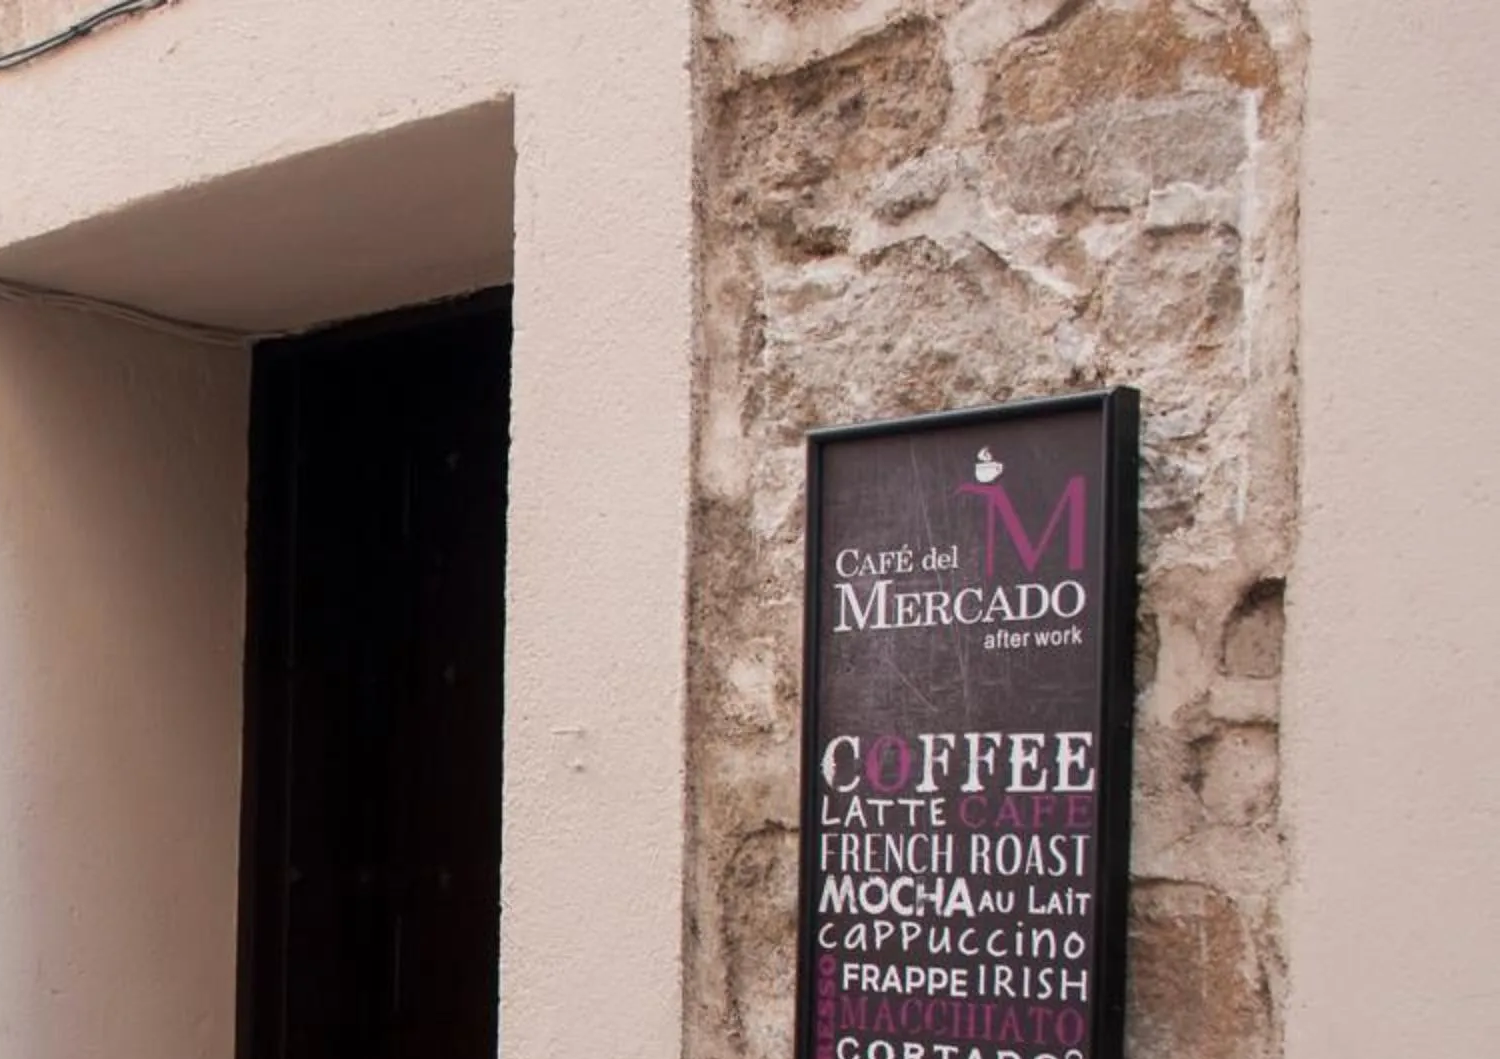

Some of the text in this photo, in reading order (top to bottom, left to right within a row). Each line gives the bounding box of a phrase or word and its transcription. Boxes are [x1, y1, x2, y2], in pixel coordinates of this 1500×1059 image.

[954, 474, 1086, 577] M
[835, 543, 959, 578] CAFÉ del
[833, 579, 1086, 633] MERCADO
[983, 624, 1083, 650] after work
[819, 731, 1095, 793] COFFEE
[820, 795, 1094, 829] LATTE CAFE
[820, 832, 1092, 877] FRENCH ROAST
[818, 874, 976, 917] MOCHA
[977, 889, 1016, 913] AU
[842, 962, 1088, 1002] FRAPPE IRISH
[839, 995, 1085, 1047] MACCHIATO
